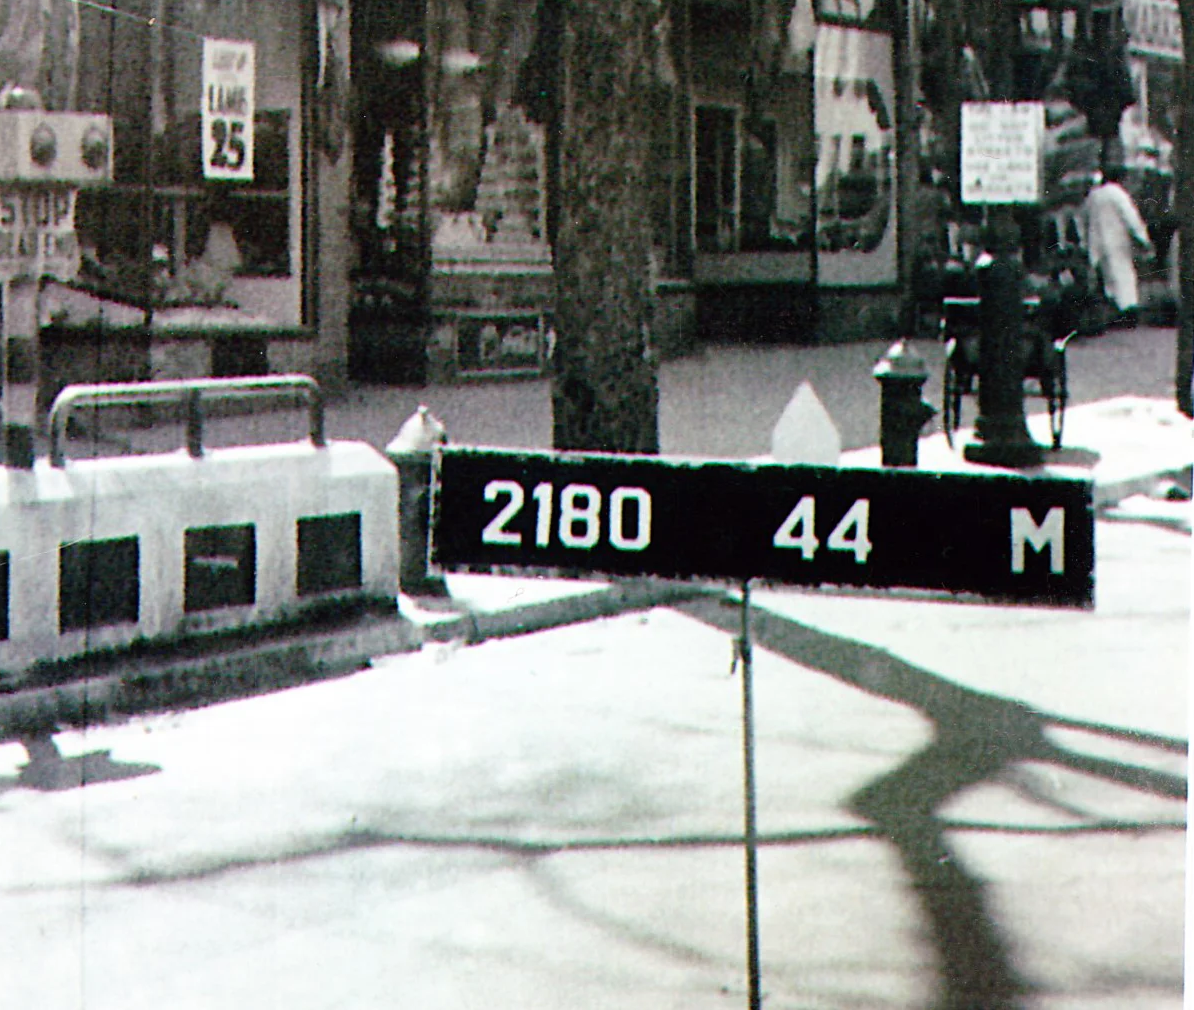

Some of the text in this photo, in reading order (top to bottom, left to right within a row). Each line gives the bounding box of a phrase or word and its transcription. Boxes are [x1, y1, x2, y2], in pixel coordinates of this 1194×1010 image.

[209, 118, 246, 172] 25
[482, 479, 1066, 575] 2180 44 M
